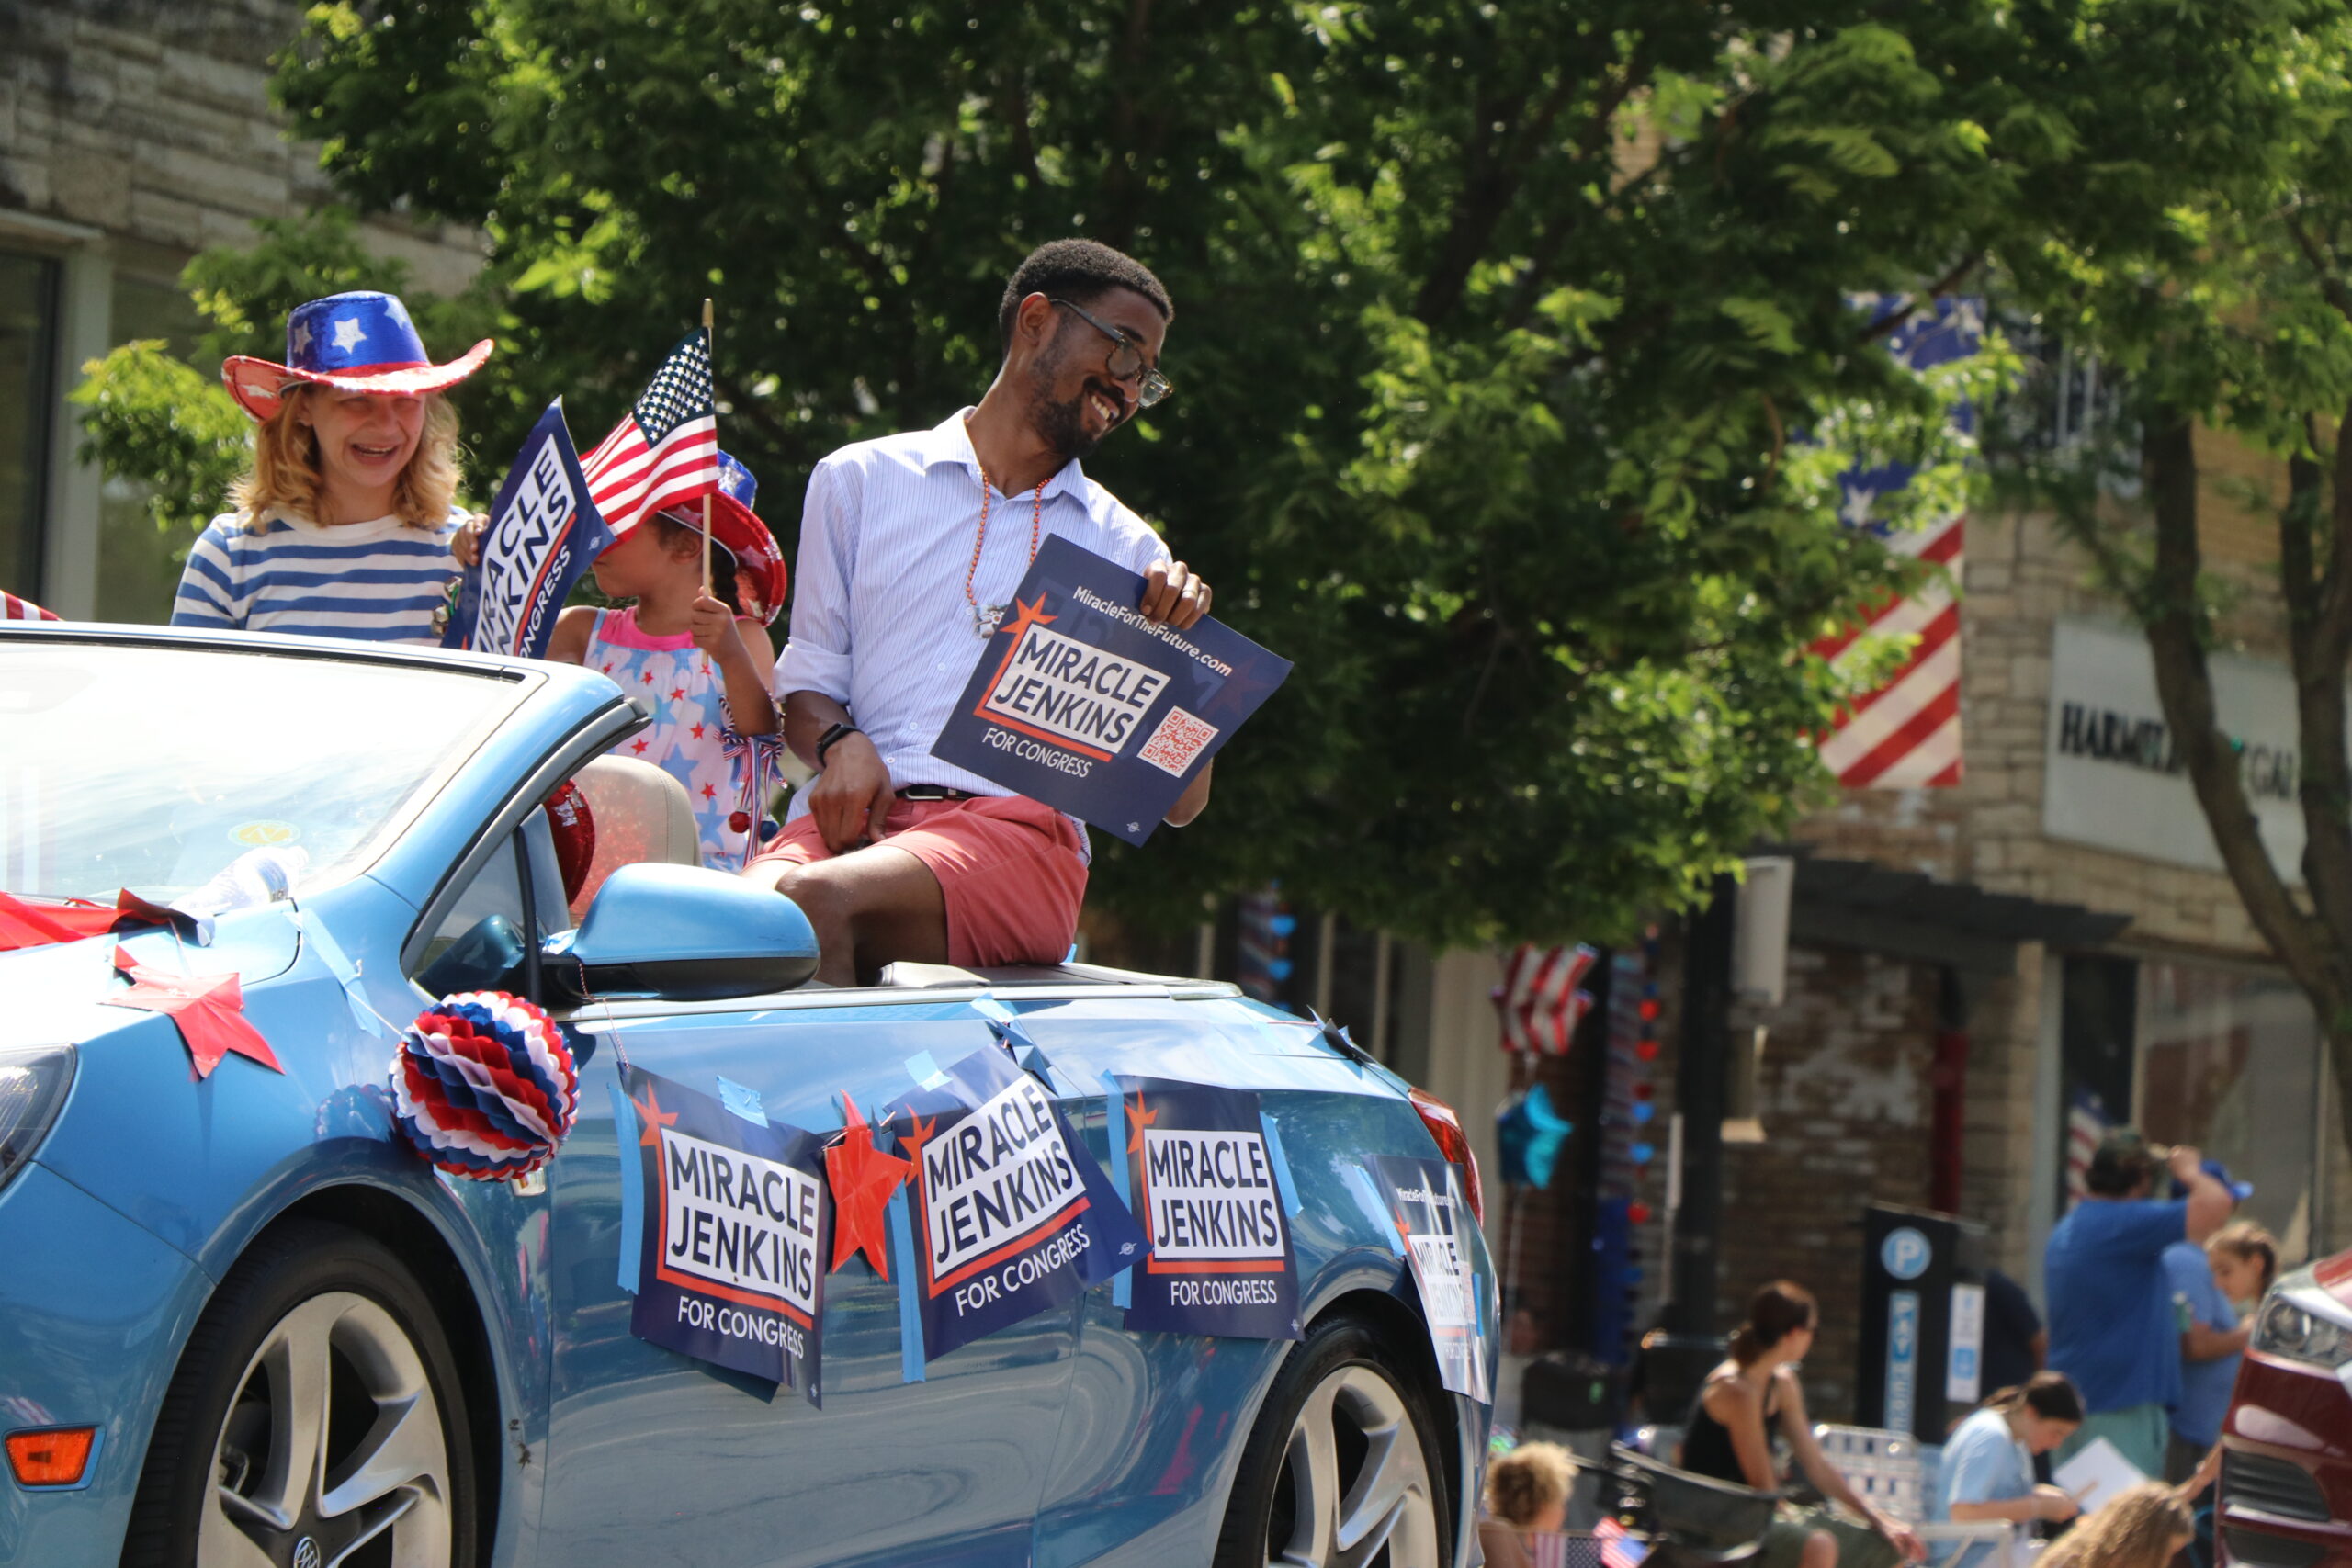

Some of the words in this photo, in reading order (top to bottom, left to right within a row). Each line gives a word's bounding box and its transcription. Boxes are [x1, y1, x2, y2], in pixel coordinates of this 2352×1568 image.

[479, 448, 557, 653] IRACLE
[494, 481, 568, 655] NKINS
[519, 545, 571, 658] ONGRESS
[1073, 586, 1233, 677] MiracleForTheFuture.com
[994, 674, 1134, 745] JENKINS
[1016, 632, 1160, 709] MIRACLE
[983, 728, 1016, 753] FOR
[1014, 739, 1093, 778] CONGRESS
[669, 1140, 815, 1239] MIRACLE
[928, 1085, 1052, 1203] MIRACLE
[1148, 1139, 1269, 1189] MIRACLE
[937, 1140, 1073, 1264] JENKINS
[1157, 1199, 1278, 1248] JENKINS
[671, 1206, 812, 1302] JENKINS
[955, 1275, 1001, 1317] FOR
[1002, 1223, 1091, 1292] CONGRESS
[1170, 1280, 1199, 1306] FOR
[1203, 1280, 1277, 1305] CONGRESS
[677, 1296, 716, 1331] FOR
[718, 1308, 804, 1359] CONGRESS
